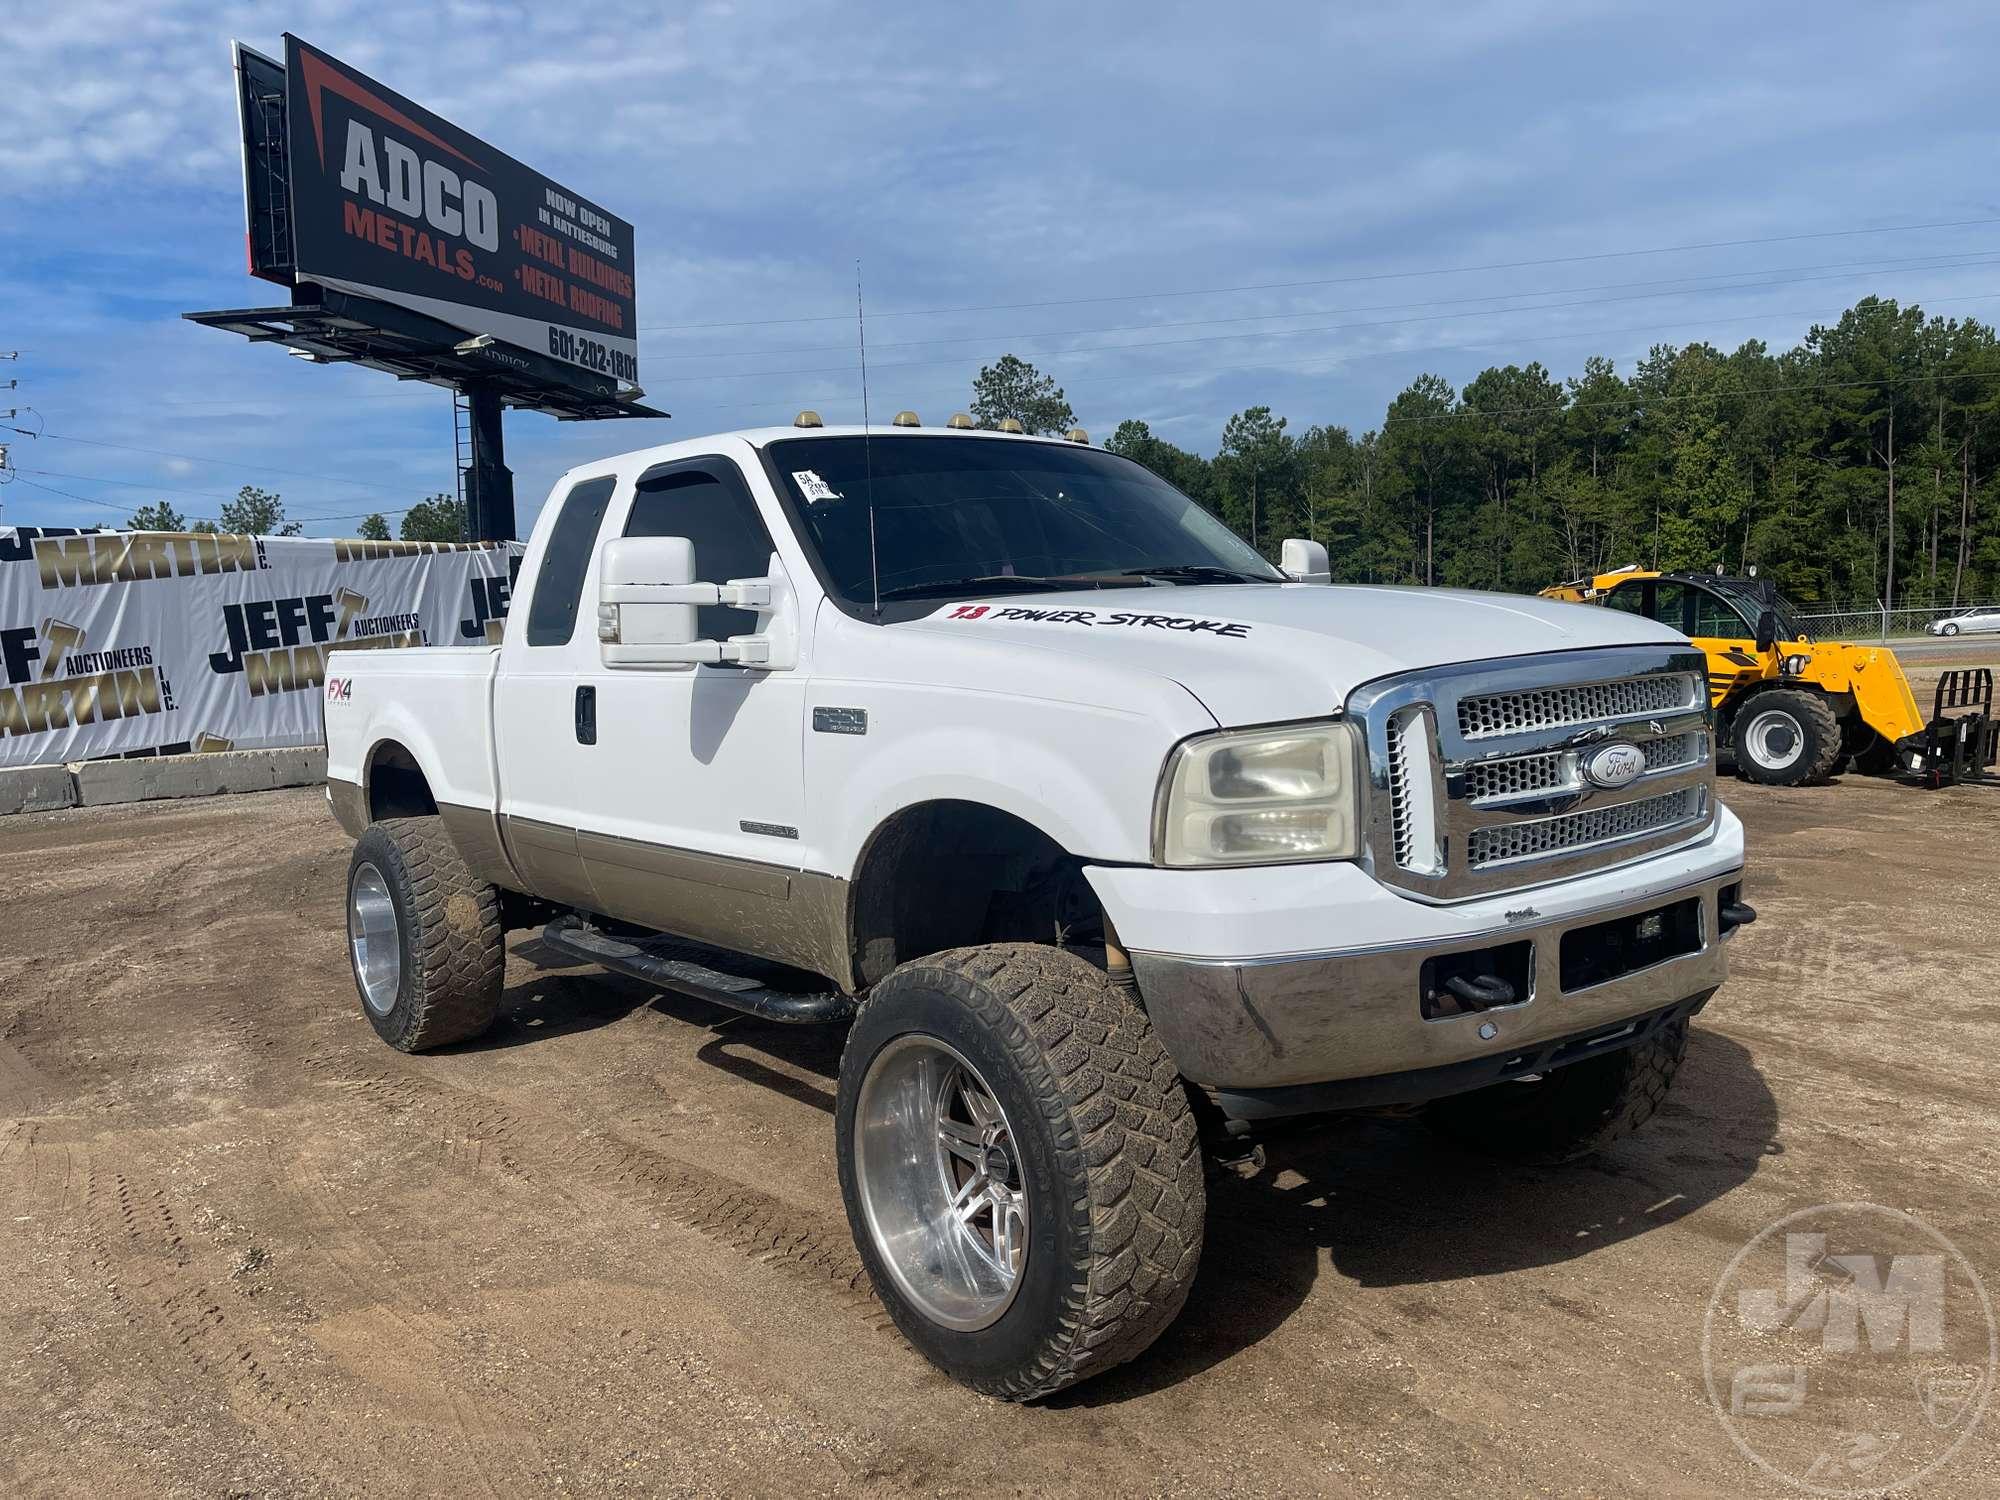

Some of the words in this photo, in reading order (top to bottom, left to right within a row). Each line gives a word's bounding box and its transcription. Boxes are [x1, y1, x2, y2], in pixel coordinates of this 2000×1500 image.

[340, 118, 499, 253] ADCO
[539, 207, 550, 225] IN
[553, 214, 617, 260] HATTIESBURG
[546, 187, 576, 218] NOW
[580, 207, 610, 237] OPEN
[520, 223, 565, 269] METAL
[568, 247, 632, 299] BUILDINGS
[522, 264, 566, 306] METAL
[570, 284, 622, 329] ROOFING
[548, 325, 638, 383] 601-202-1801
[33, 534, 257, 589] MARTIN
[209, 594, 336, 673] JEFF
[354, 613, 419, 637] AUCTIONEERS
[989, 608, 1096, 627] POWER
[1097, 613, 1253, 639] STROKE
[66, 646, 153, 676] AUCTIONEERS
[158, 665, 179, 711] INC.
[327, 678, 353, 700] FX4
[1606, 751, 1638, 778] Ford
